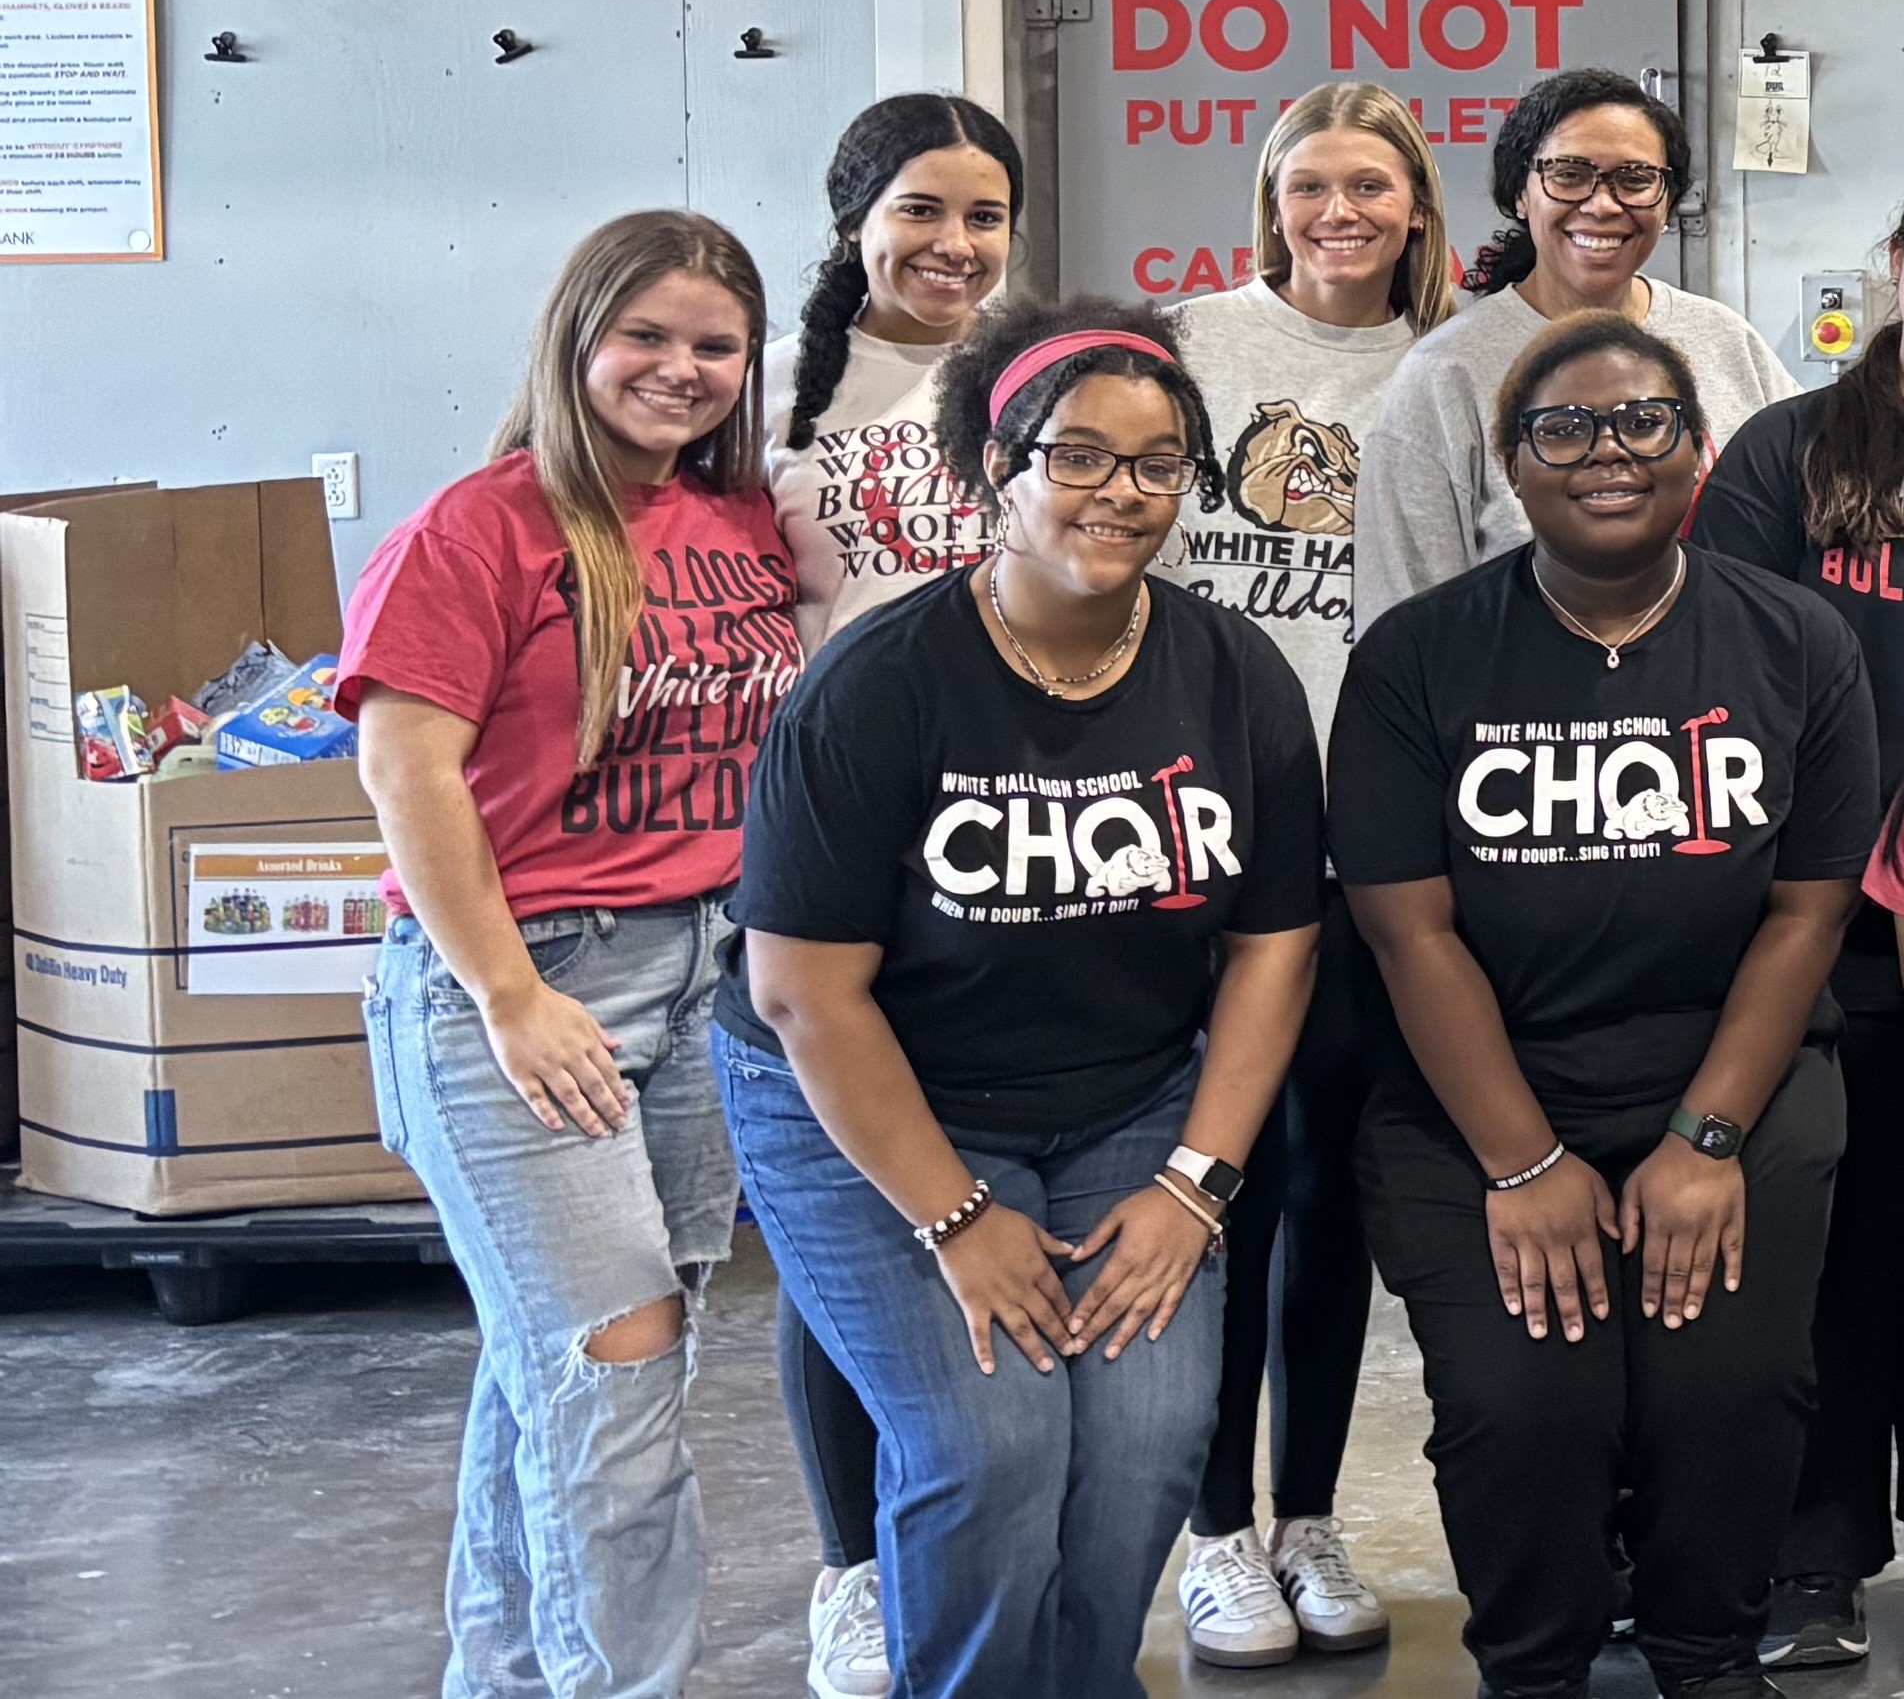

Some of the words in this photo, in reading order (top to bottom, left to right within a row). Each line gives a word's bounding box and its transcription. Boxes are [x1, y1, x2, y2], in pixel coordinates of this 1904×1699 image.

[1126, 98, 1256, 145] PUT
[816, 422, 929, 455] WOO
[816, 447, 932, 479] WOO
[826, 513, 964, 550] WOOF
[838, 545, 964, 579] WOOF
[1186, 531, 1294, 566] WHITE
[1304, 538, 1354, 570] HA
[1475, 722, 1520, 743] WHITE
[1525, 722, 1564, 742] HALL
[1570, 721, 1608, 741] HIGH
[1612, 716, 1671, 737] SCHOOL
[942, 771, 989, 796] WHITE
[996, 772, 1037, 795] HALL
[1038, 777, 1072, 798] HIGH
[1076, 770, 1143, 796] SCHOOL
[257, 860, 303, 872] Assorted
[306, 859, 342, 871] Drinks
[1502, 848, 1518, 862] IN
[1613, 845, 1627, 860] IT
[1629, 843, 1661, 859] OUT!
[932, 891, 964, 920] WHEN
[969, 906, 984, 922] IN
[1091, 901, 1104, 916] IT
[1108, 898, 1139, 914] OUT!
[63, 961, 97, 986] Heavy
[100, 964, 127, 989] Duty
